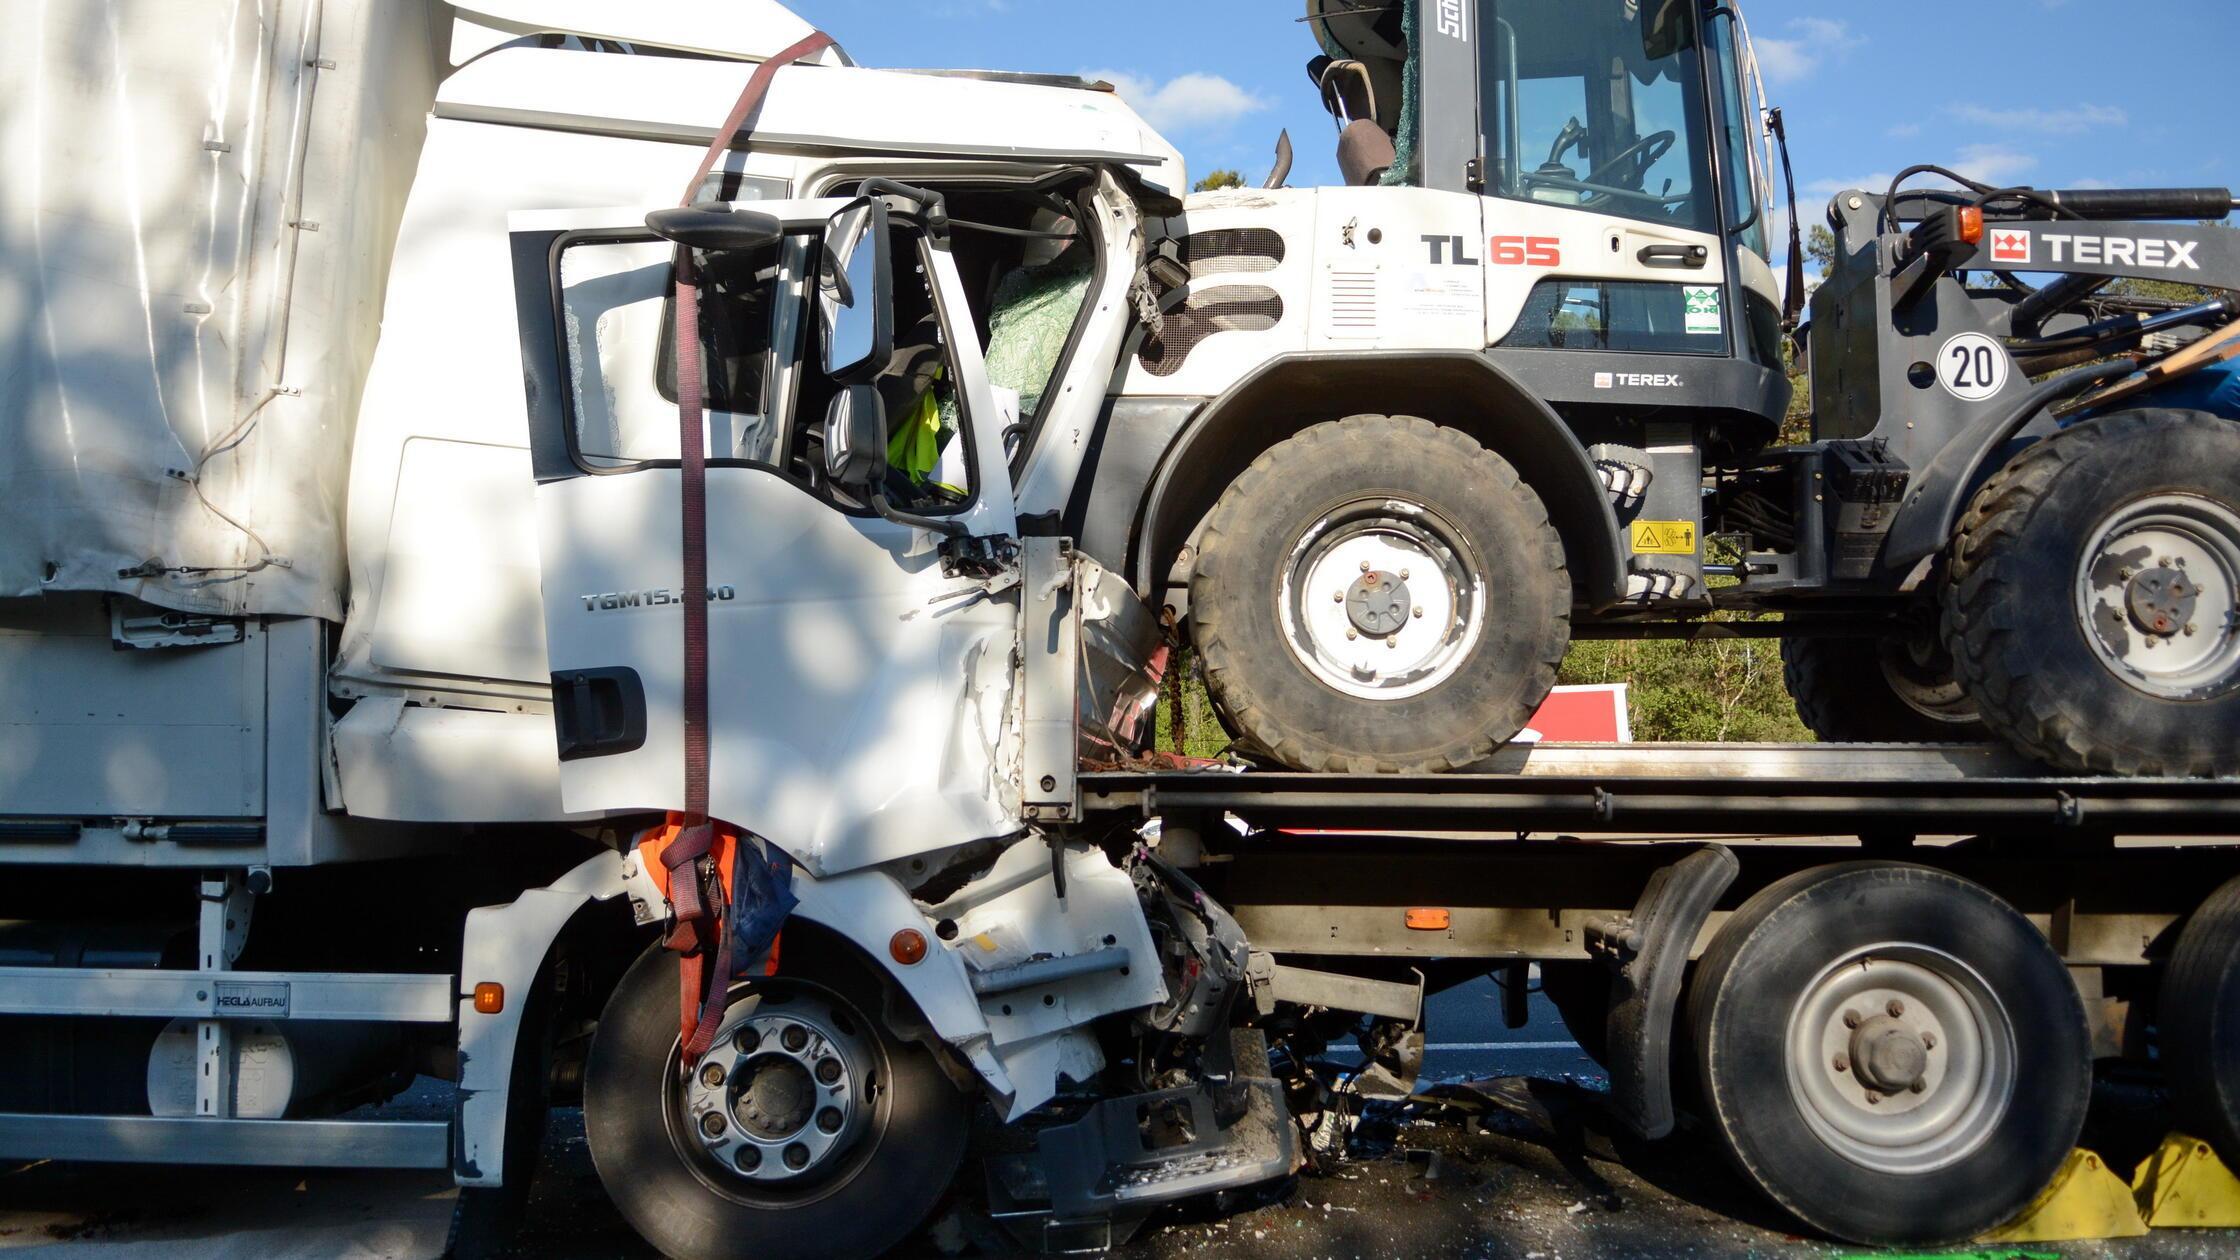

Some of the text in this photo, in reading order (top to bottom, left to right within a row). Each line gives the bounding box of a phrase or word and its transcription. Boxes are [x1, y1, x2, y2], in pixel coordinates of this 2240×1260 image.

[1420, 234, 1561, 267] TL 65
[2041, 233, 2200, 269] TEREX
[1951, 345, 1994, 388] 20
[250, 997, 285, 1007] AUFBAU
